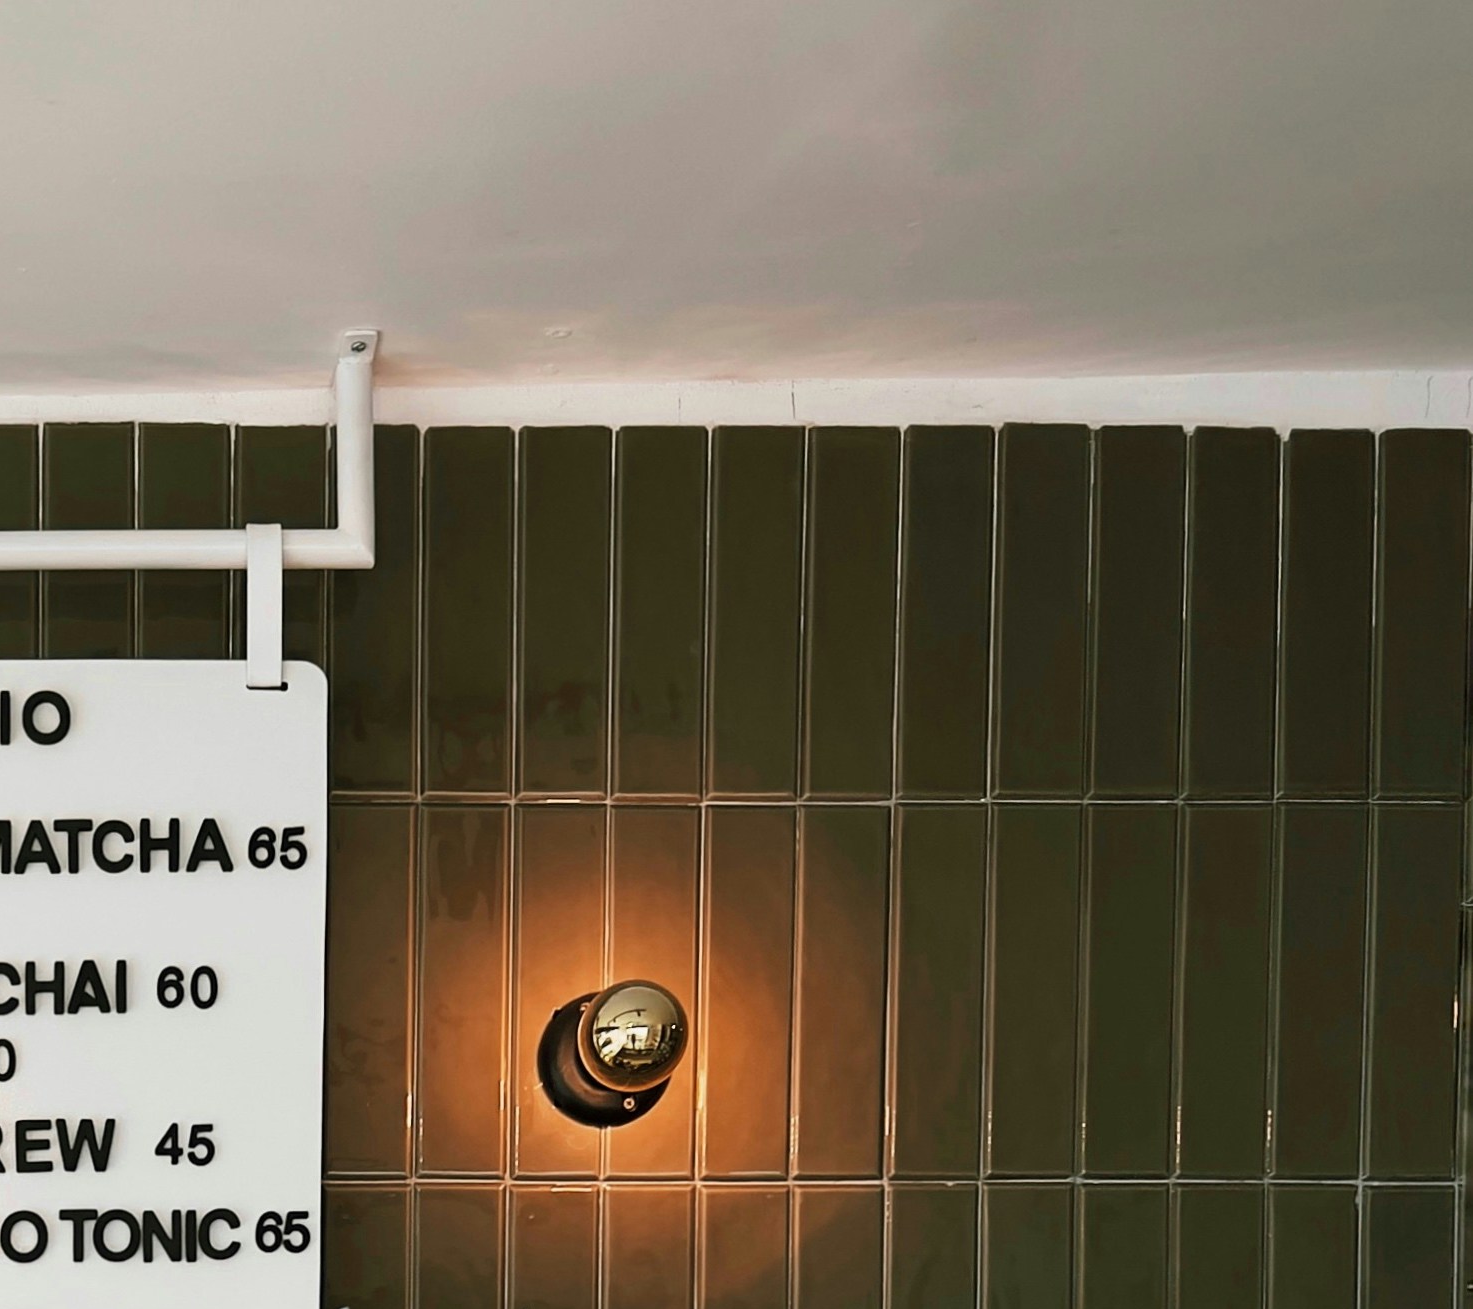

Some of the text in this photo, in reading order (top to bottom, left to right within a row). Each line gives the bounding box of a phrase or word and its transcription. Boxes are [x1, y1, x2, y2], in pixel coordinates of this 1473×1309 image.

[248, 827, 307, 870] 65
[157, 966, 218, 1009] 60
[155, 1123, 215, 1166] 45
[59, 1209, 241, 1263] TONIC
[256, 1211, 310, 1253] 65
